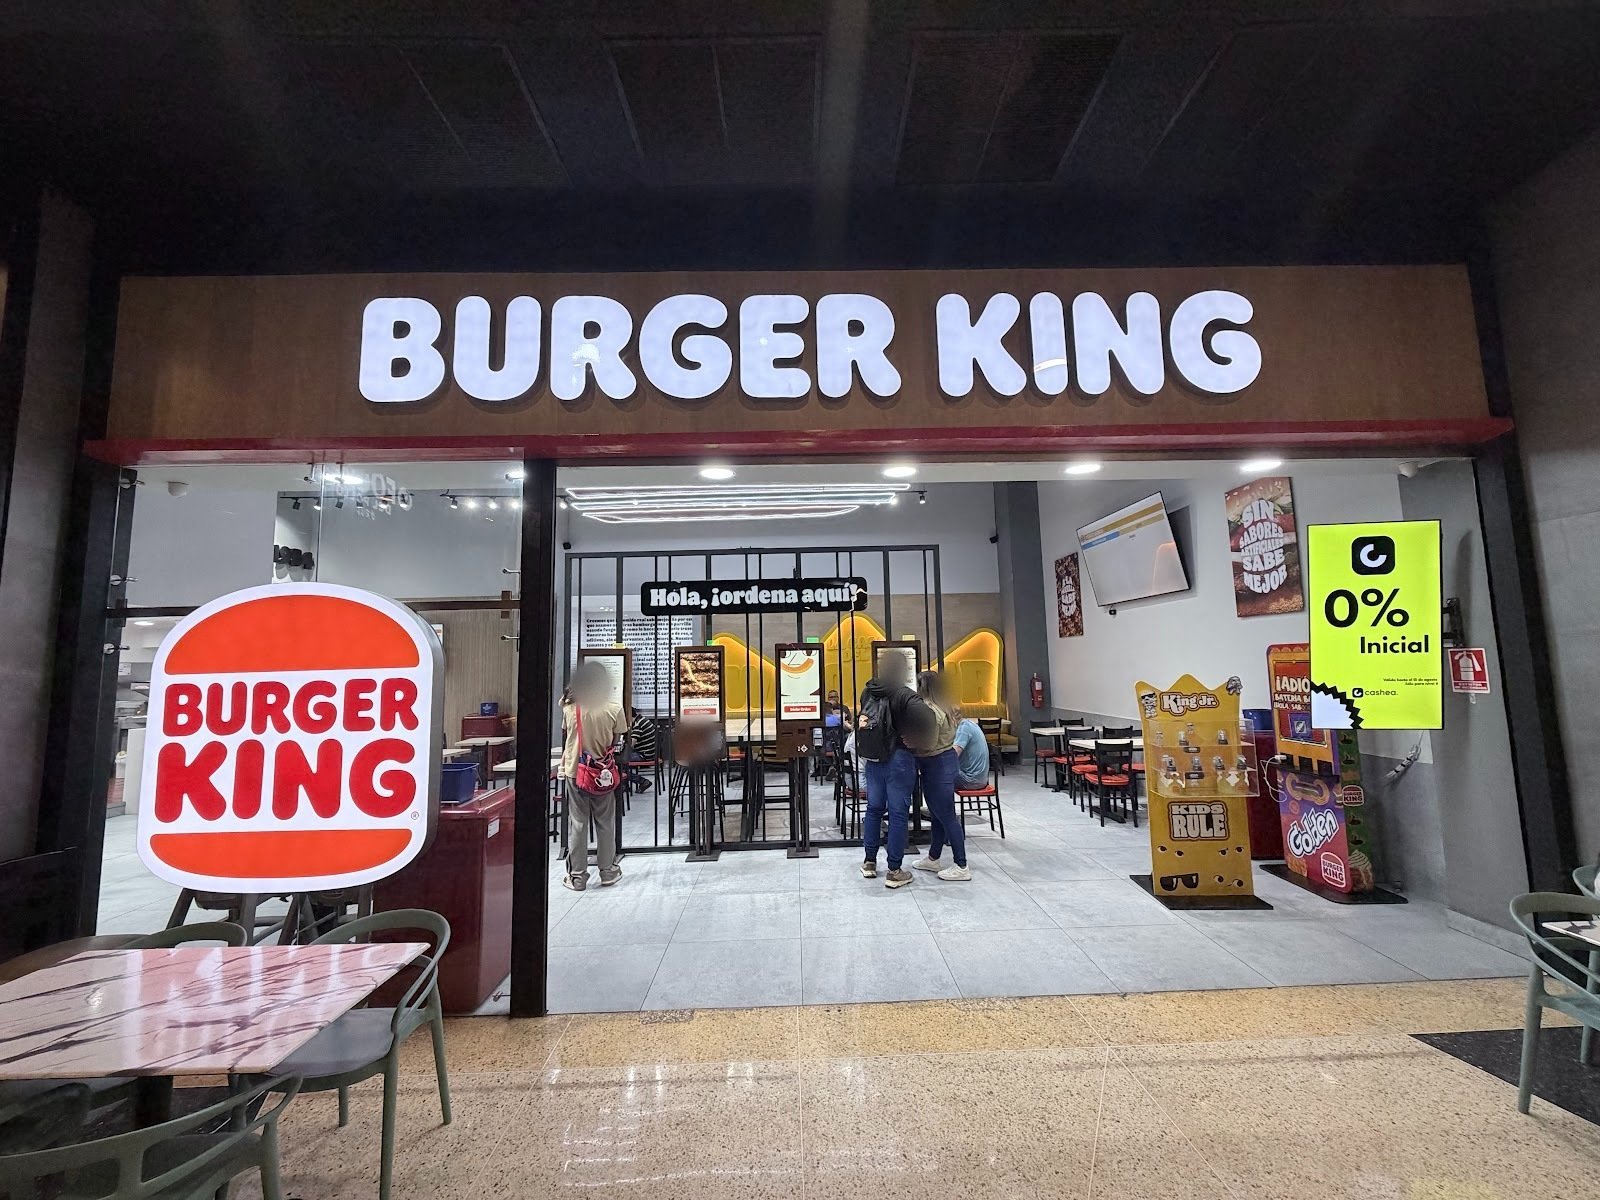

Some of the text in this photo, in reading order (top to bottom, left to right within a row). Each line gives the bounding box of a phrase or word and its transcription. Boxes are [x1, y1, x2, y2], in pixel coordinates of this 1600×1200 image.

[359, 290, 1262, 402] BURGER KING
[1242, 500, 1275, 529] SIN
[1240, 521, 1285, 549] SABORES
[1243, 548, 1285, 571] SABE
[1243, 564, 1288, 593] MEJOR
[650, 582, 859, 609] Hola, ¡ordena aquí!
[1325, 588, 1410, 628] 0%
[1360, 634, 1429, 654] Inicial
[163, 678, 418, 737] BURGER
[1162, 693, 1217, 714] King Jr.
[155, 738, 417, 823] KING
[1171, 804, 1224, 814] KIDS
[1172, 814, 1226, 838] RULE
[1289, 810, 1338, 857] Golden
[1322, 860, 1344, 873] BURGER
[1322, 866, 1345, 882] KING
